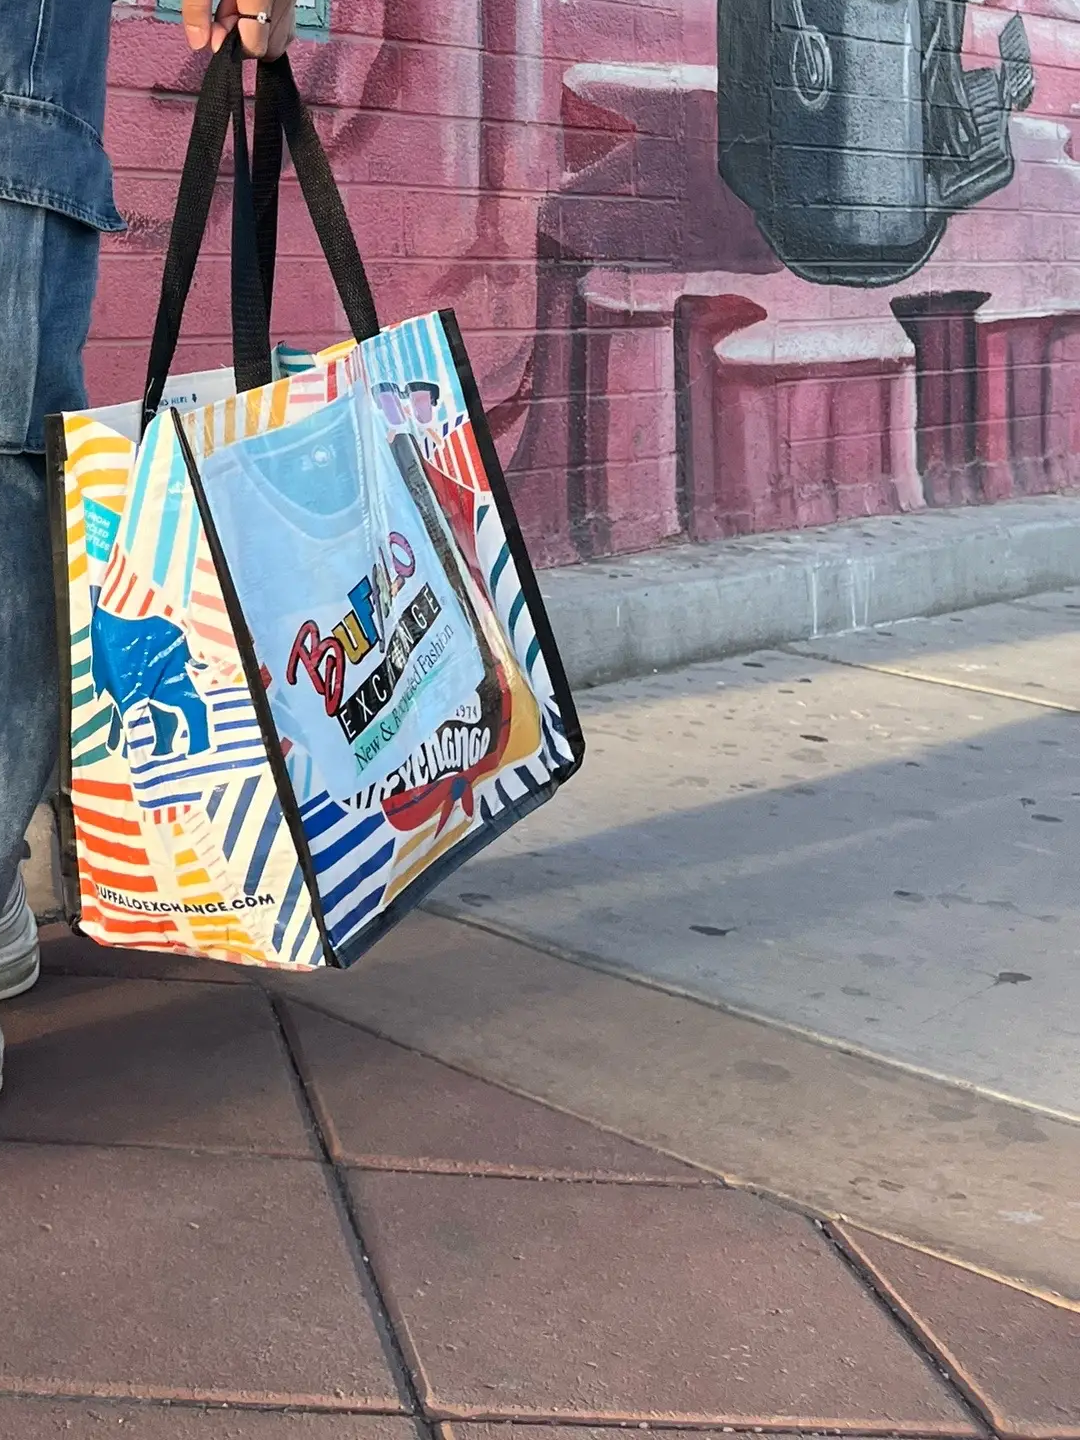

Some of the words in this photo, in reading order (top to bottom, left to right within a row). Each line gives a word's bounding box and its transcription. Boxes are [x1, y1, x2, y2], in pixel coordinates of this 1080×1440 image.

[354, 736, 380, 771] New
[380, 721, 395, 742] &
[417, 623, 454, 675] Fashion
